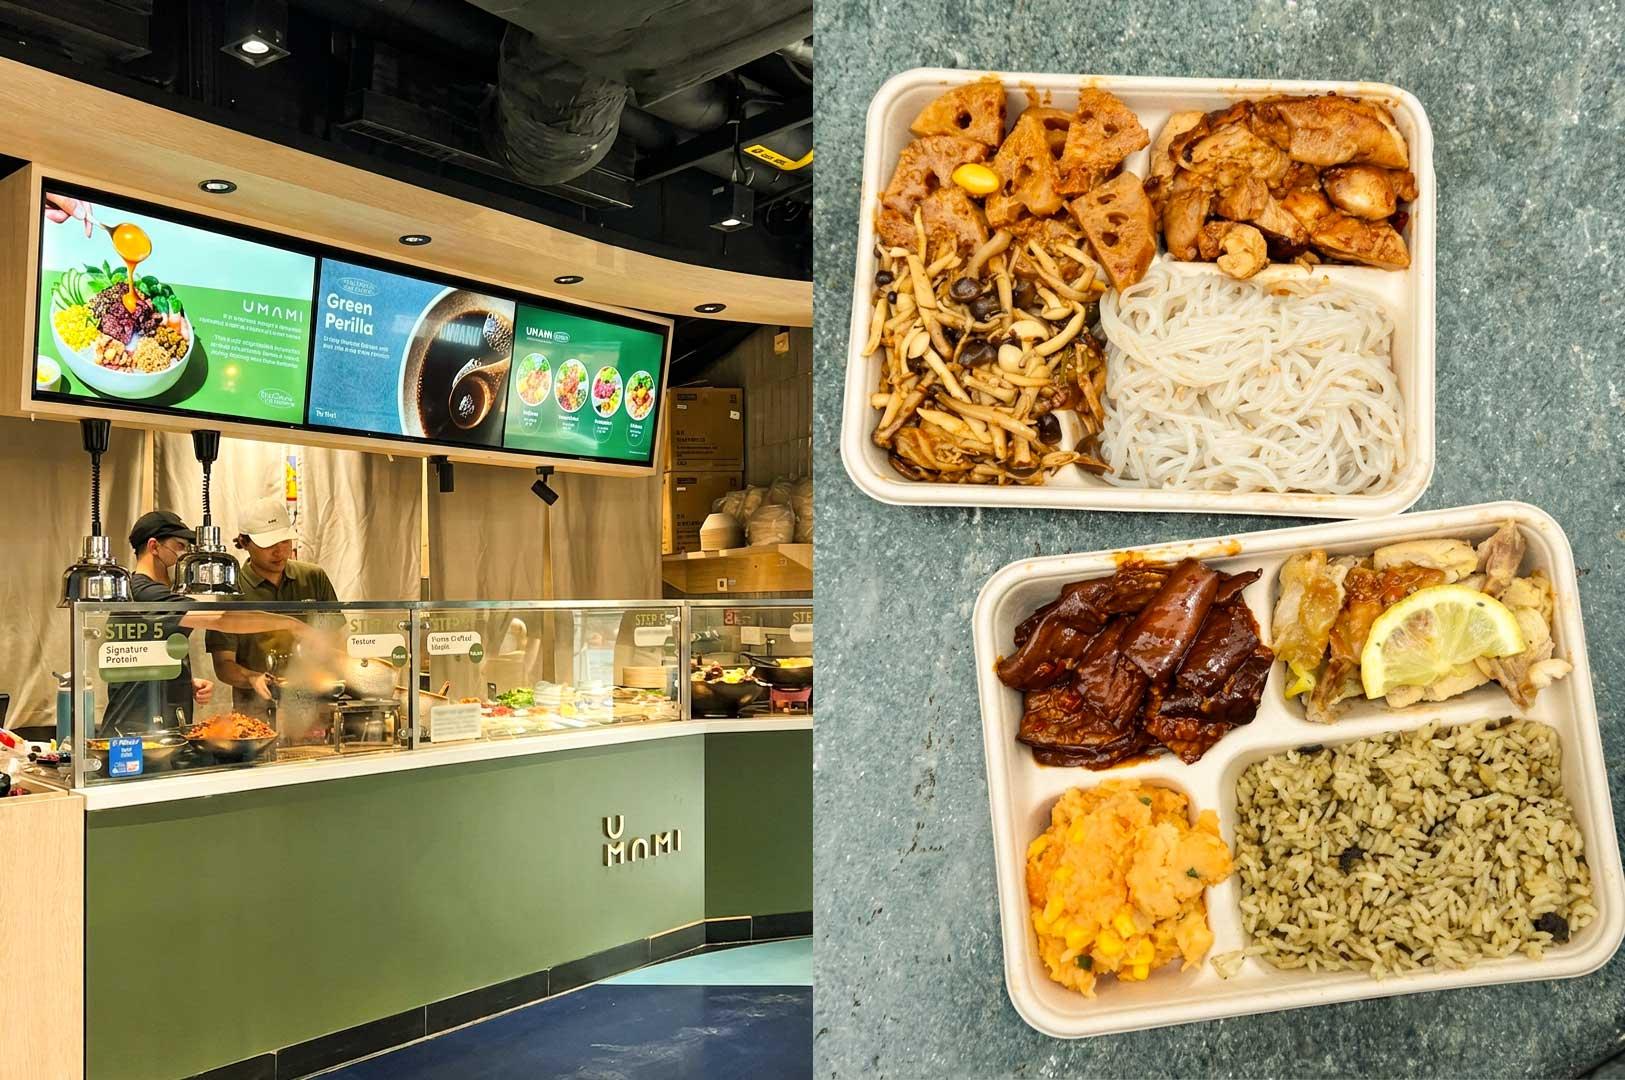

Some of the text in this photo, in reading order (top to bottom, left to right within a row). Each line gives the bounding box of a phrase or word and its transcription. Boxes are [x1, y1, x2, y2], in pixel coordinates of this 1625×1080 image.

[243, 299, 304, 323] UMAMI
[327, 293, 373, 316] Green
[325, 313, 374, 336] Perilla
[636, 613, 657, 626] STEP
[105, 622, 164, 640] STEP 5
[106, 646, 149, 656] Signature
[106, 656, 138, 664] Protein
